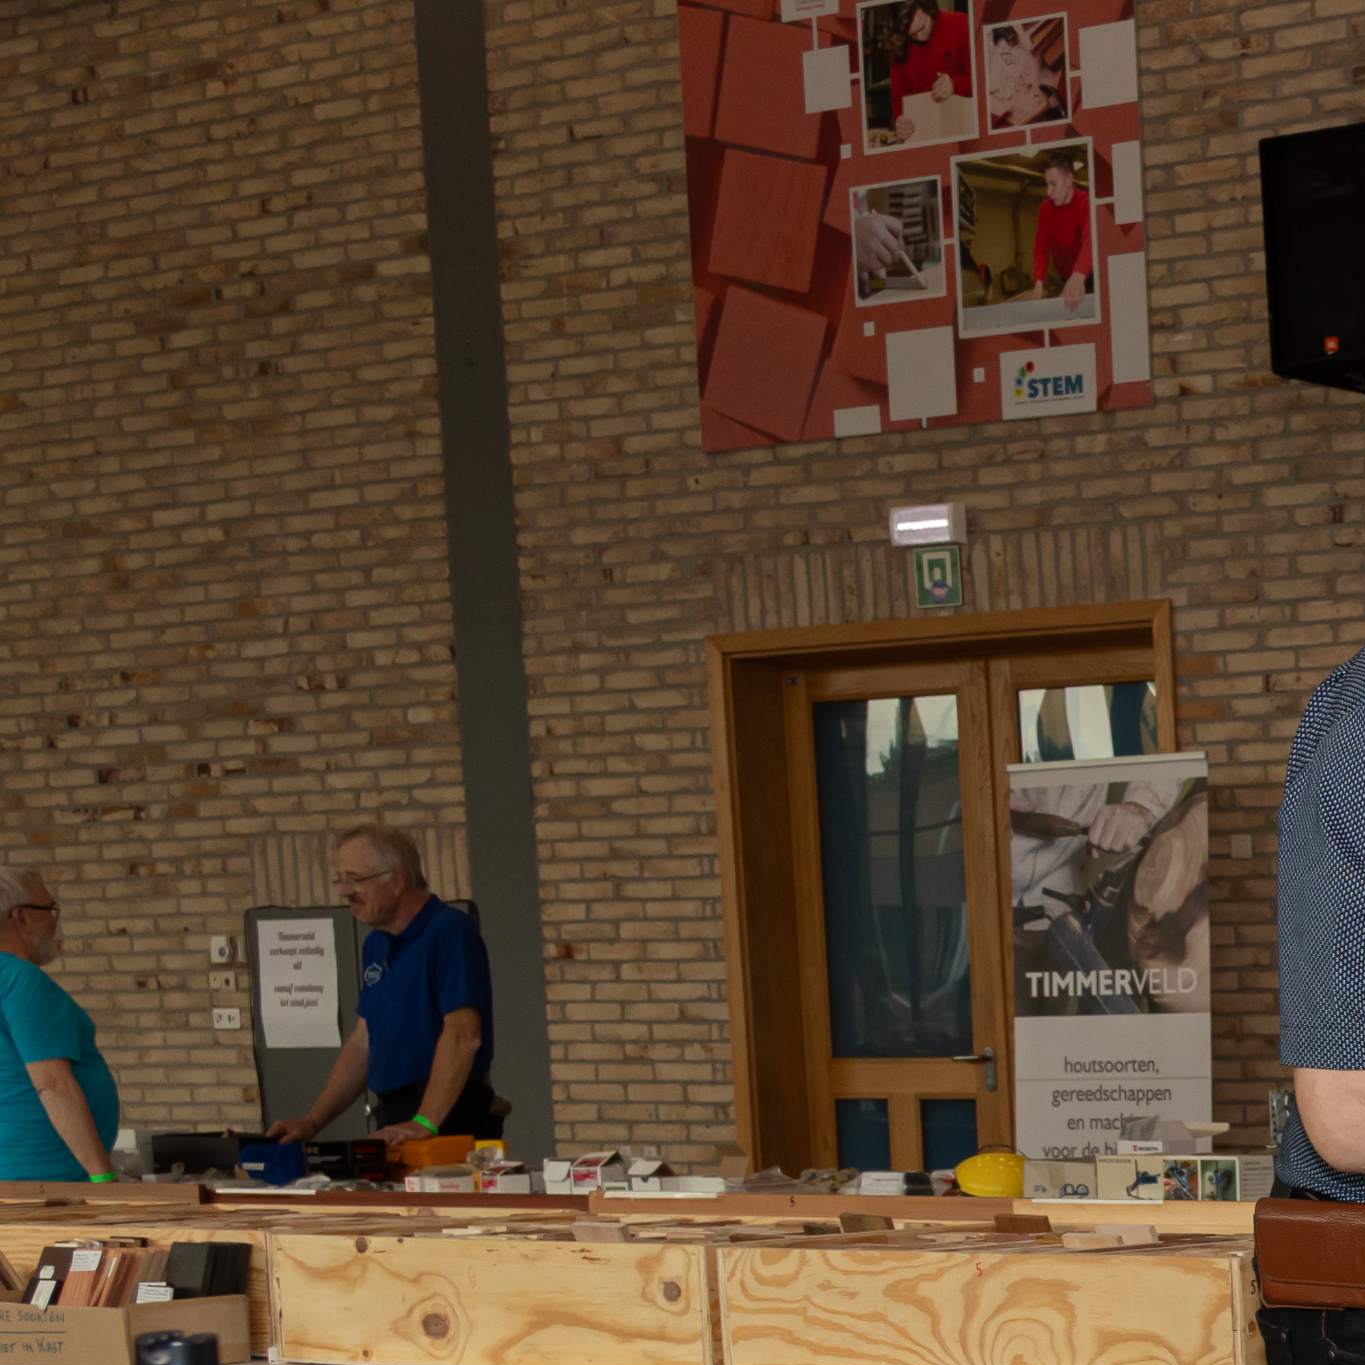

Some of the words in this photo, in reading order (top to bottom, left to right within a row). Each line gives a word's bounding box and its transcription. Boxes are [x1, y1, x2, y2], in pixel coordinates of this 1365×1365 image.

[1027, 374, 1084, 399] STEM
[1025, 967, 1198, 998] TIMMERVELD
[1063, 1056, 1160, 1074] houtsoorten,
[1051, 1084, 1173, 1108] gereedschappen
[1067, 1118, 1085, 1131] en
[1042, 1145, 1078, 1159] voor
[1081, 1141, 1100, 1159] de
